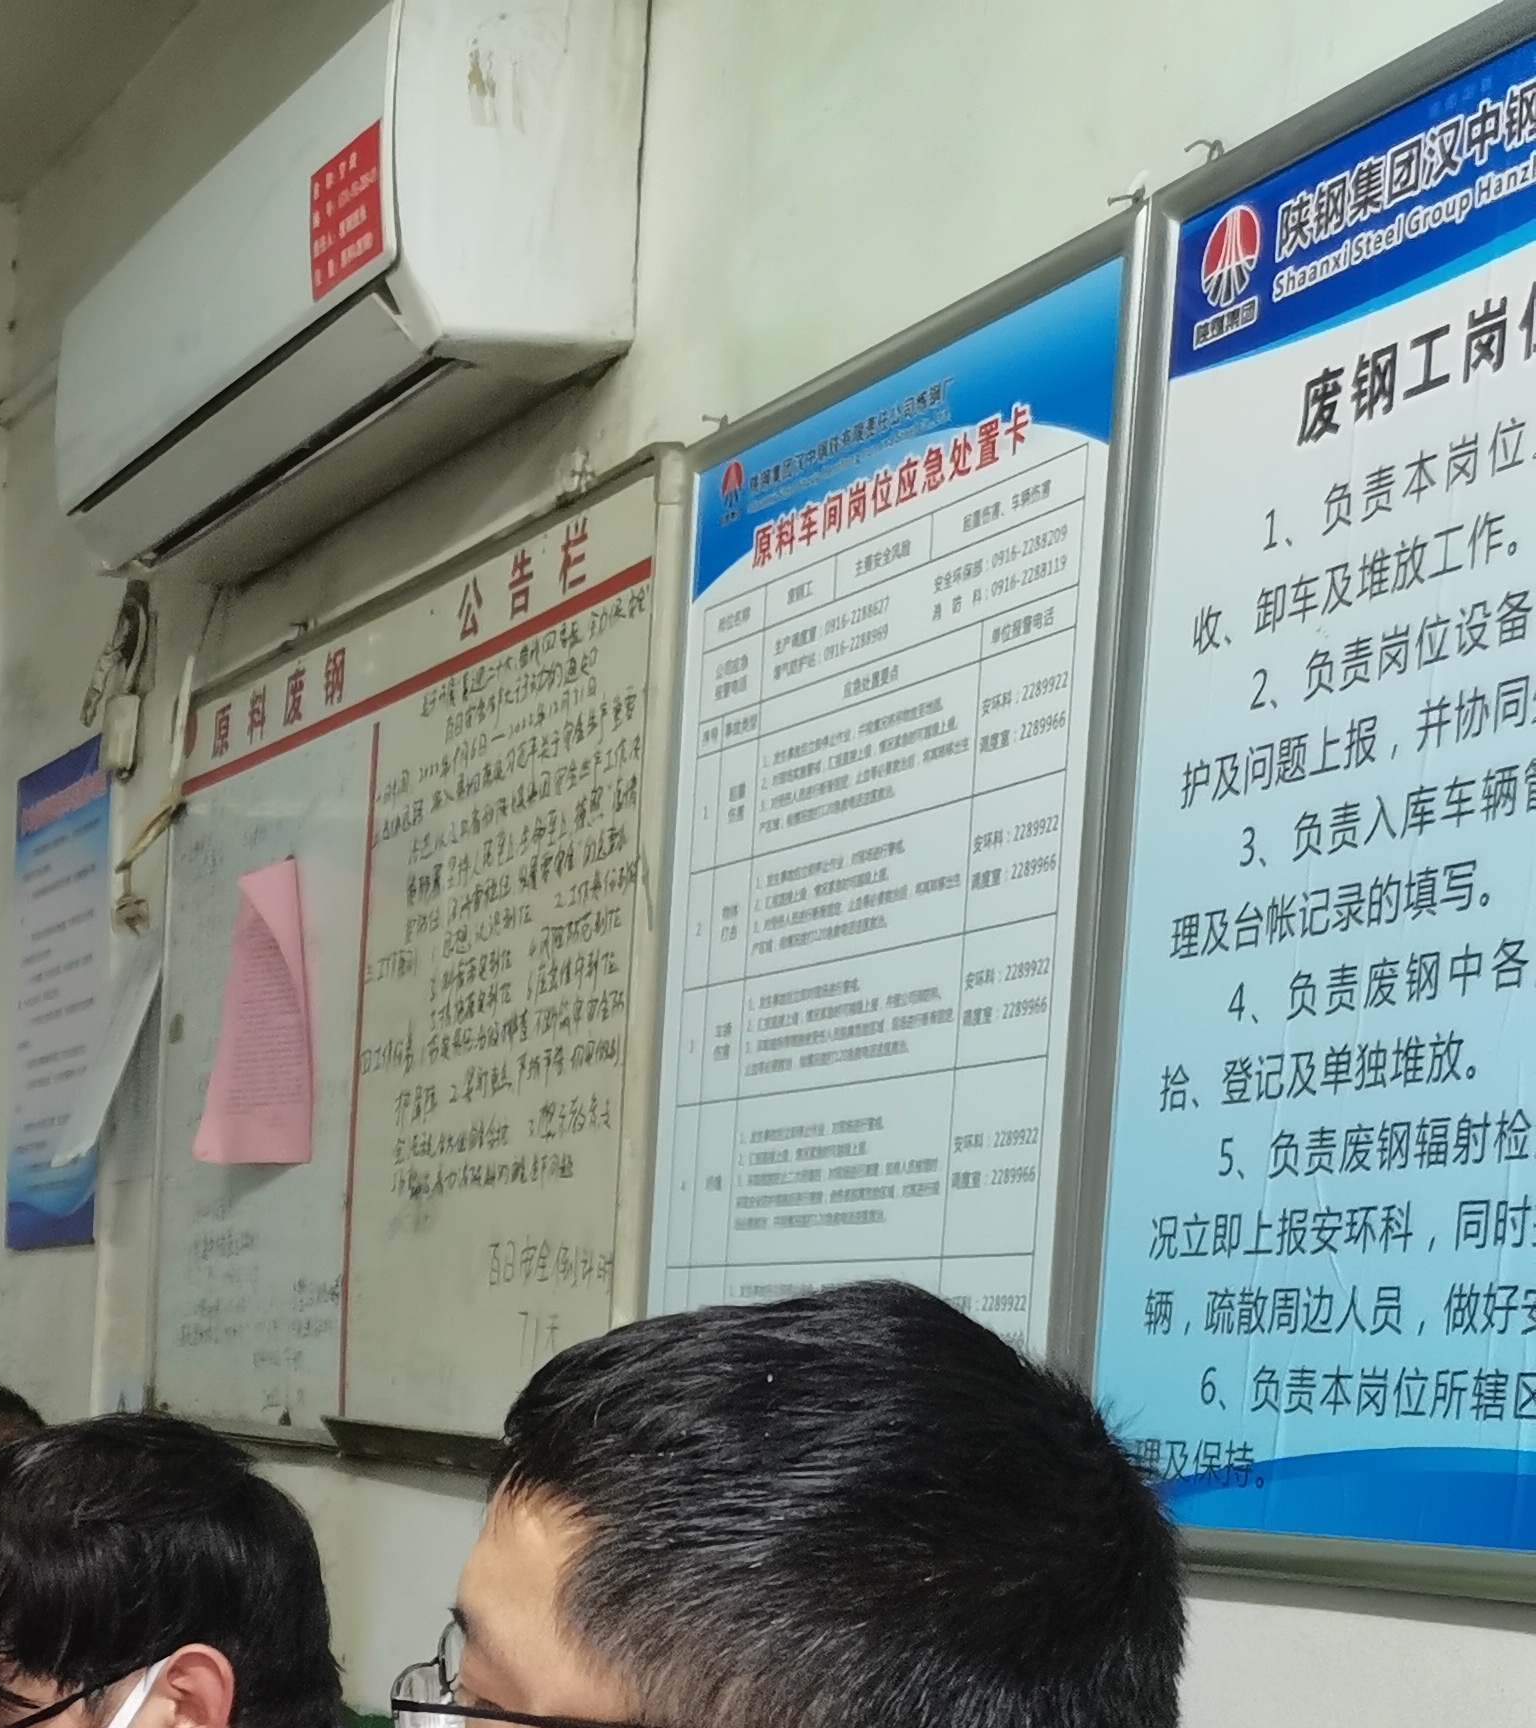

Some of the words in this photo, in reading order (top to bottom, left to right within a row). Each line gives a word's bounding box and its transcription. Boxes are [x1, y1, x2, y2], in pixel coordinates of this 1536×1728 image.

[1274, 242, 1348, 300] Shaanxi
[1354, 219, 1401, 263] Steel
[1408, 195, 1470, 241] Group
[751, 404, 1030, 569] 原料车间岗位应急处置卡
[1263, 418, 1536, 551] 1、负责本岗位
[457, 517, 588, 640] 公告栏
[1192, 511, 1518, 656] 收、卸车及堆放工作。
[211, 646, 347, 759] 原料废钢
[1250, 590, 1533, 711] 2、负责岗位设备
[1180, 675, 1536, 810] 护及问题上报，并协同
[1170, 859, 1489, 960] 理及台帐记录的填写。
[1159, 1031, 1477, 1113] 拾、登记及单独堆放。
[1149, 1194, 1536, 1260] 况立即上报安环科，同时
